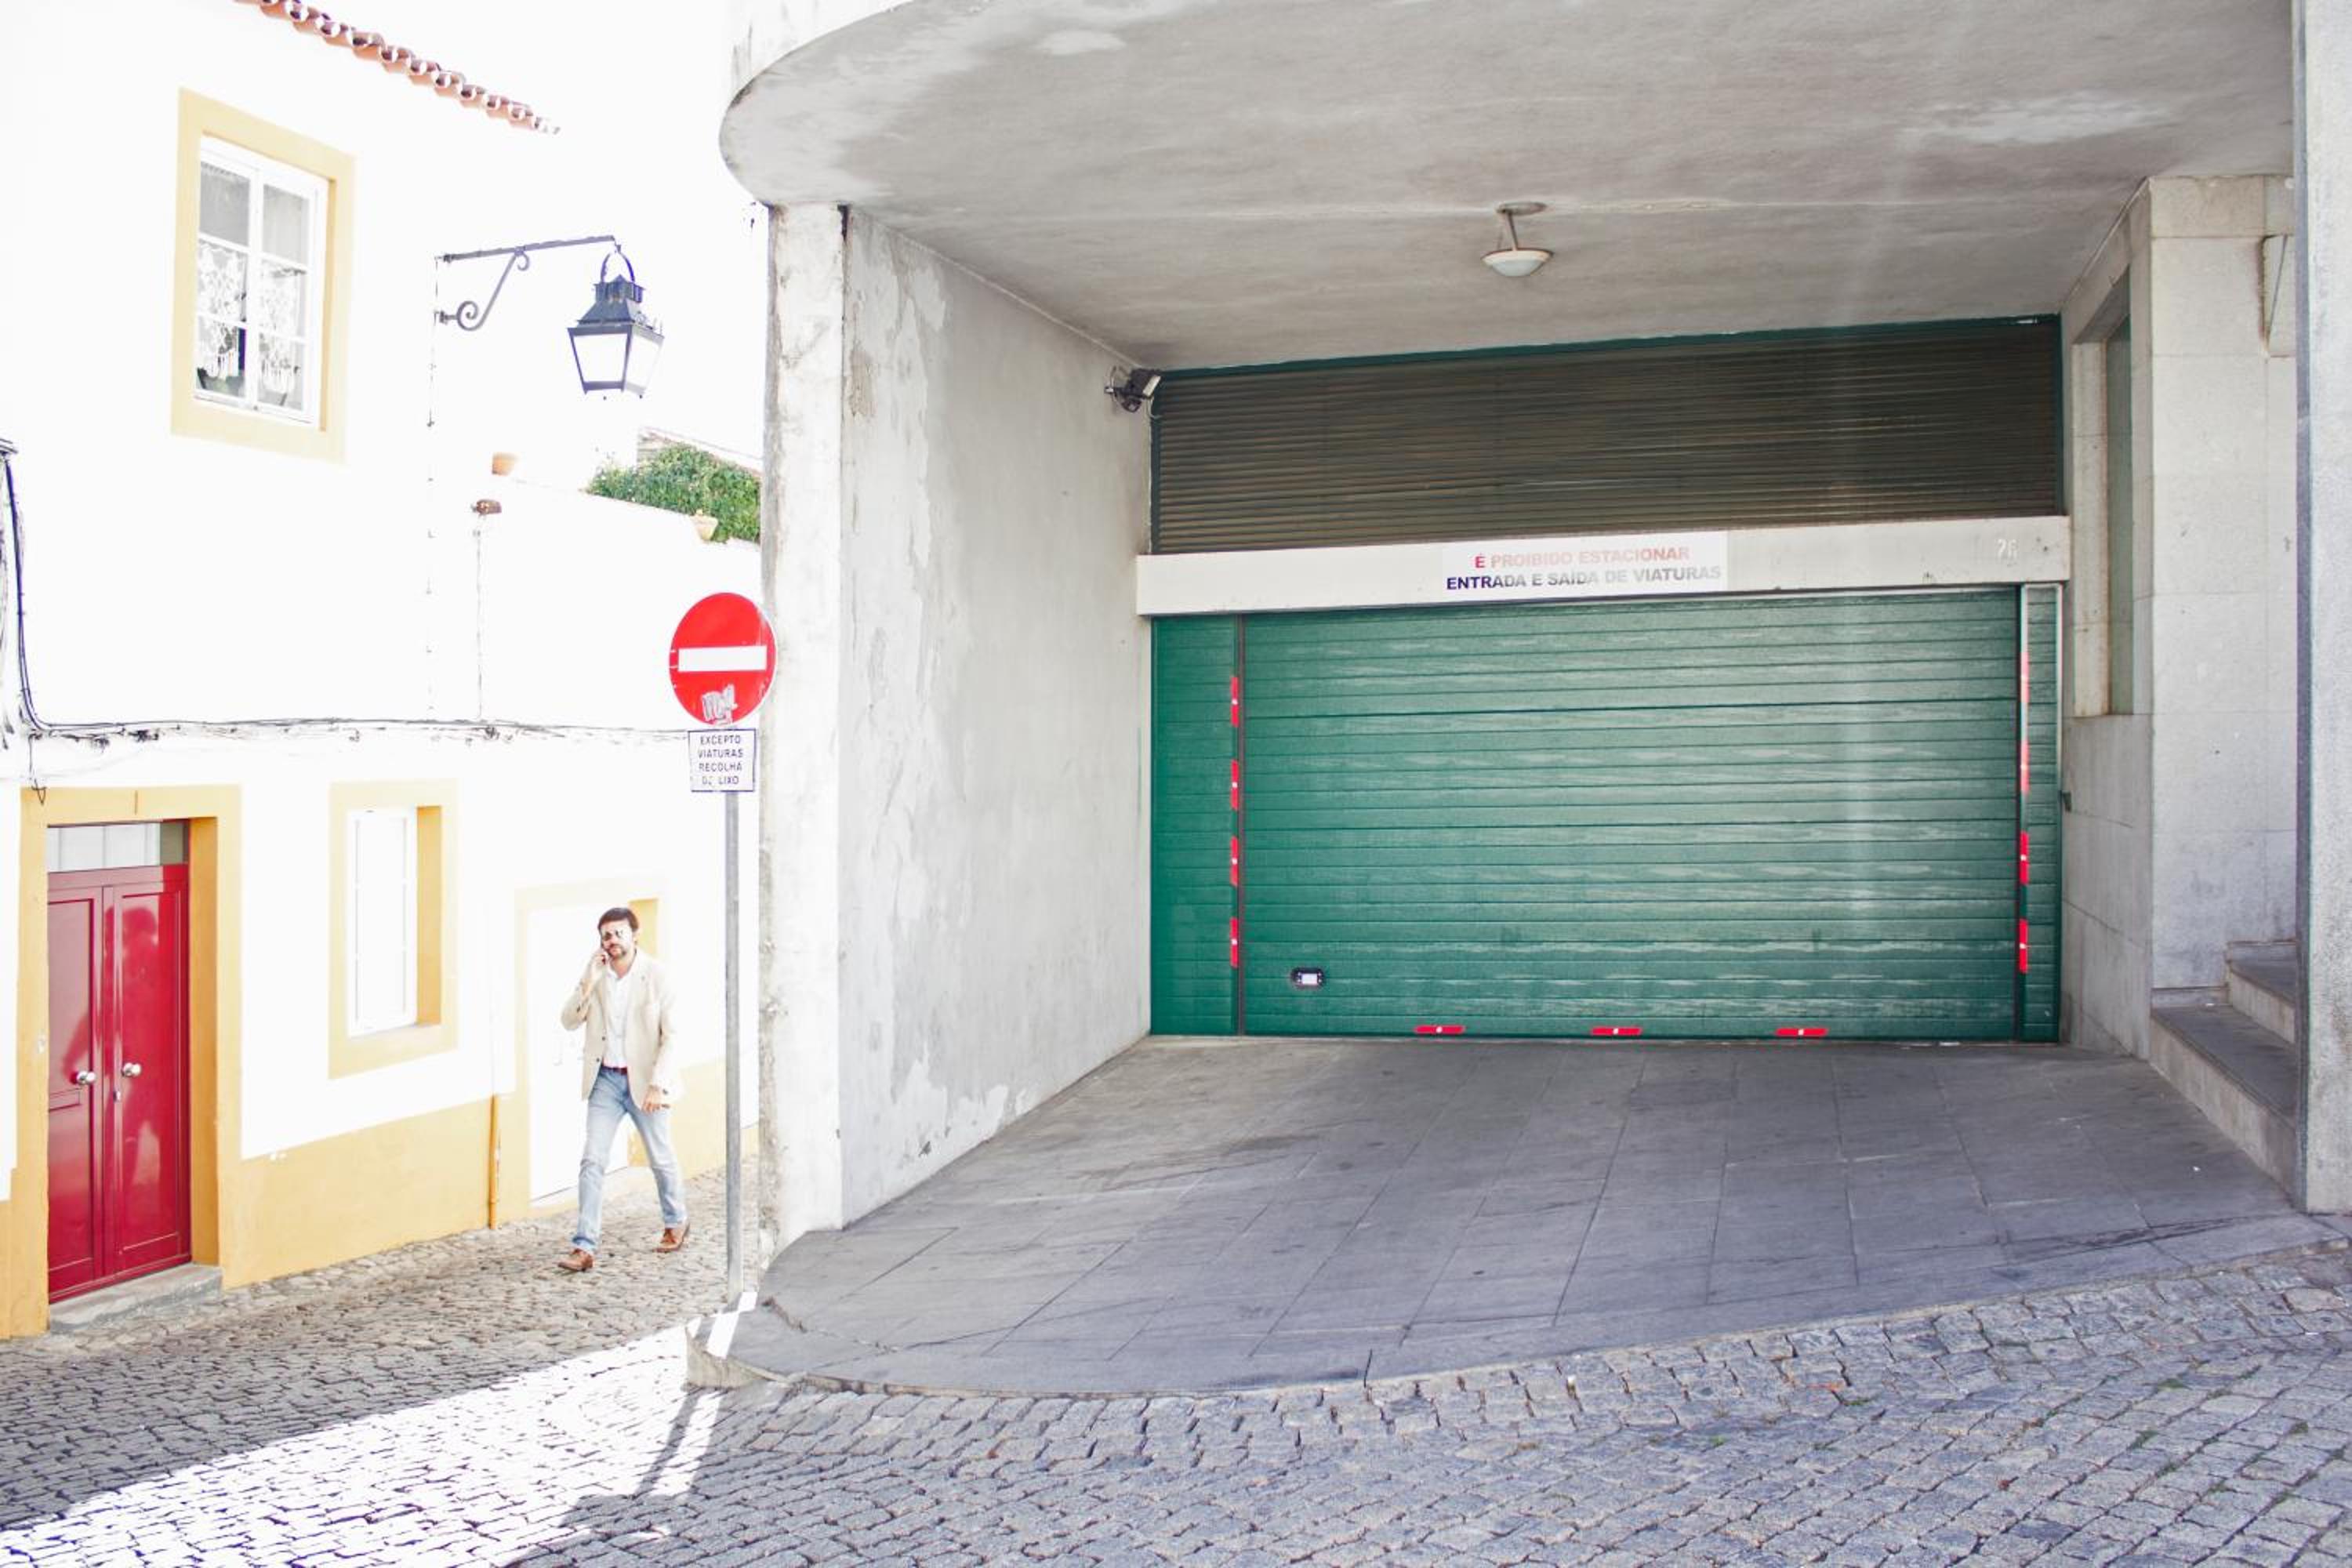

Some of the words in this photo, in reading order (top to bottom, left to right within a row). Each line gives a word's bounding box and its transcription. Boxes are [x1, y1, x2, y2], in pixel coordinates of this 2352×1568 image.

[1475, 552, 1486, 568] É
[1490, 550, 1573, 568] PROIBIDO
[1579, 546, 1690, 565] ESTACIONAR
[1446, 574, 1526, 590] ENTRADA
[1532, 573, 1542, 586] E
[1605, 570, 1627, 584] DE
[1633, 566, 1721, 582] VIATURAS
[700, 735, 741, 745] EXCEPTO
[698, 749, 743, 759] VIATURAS
[699, 762, 742, 772] RECOLHA
[718, 775, 739, 785] LIXO
